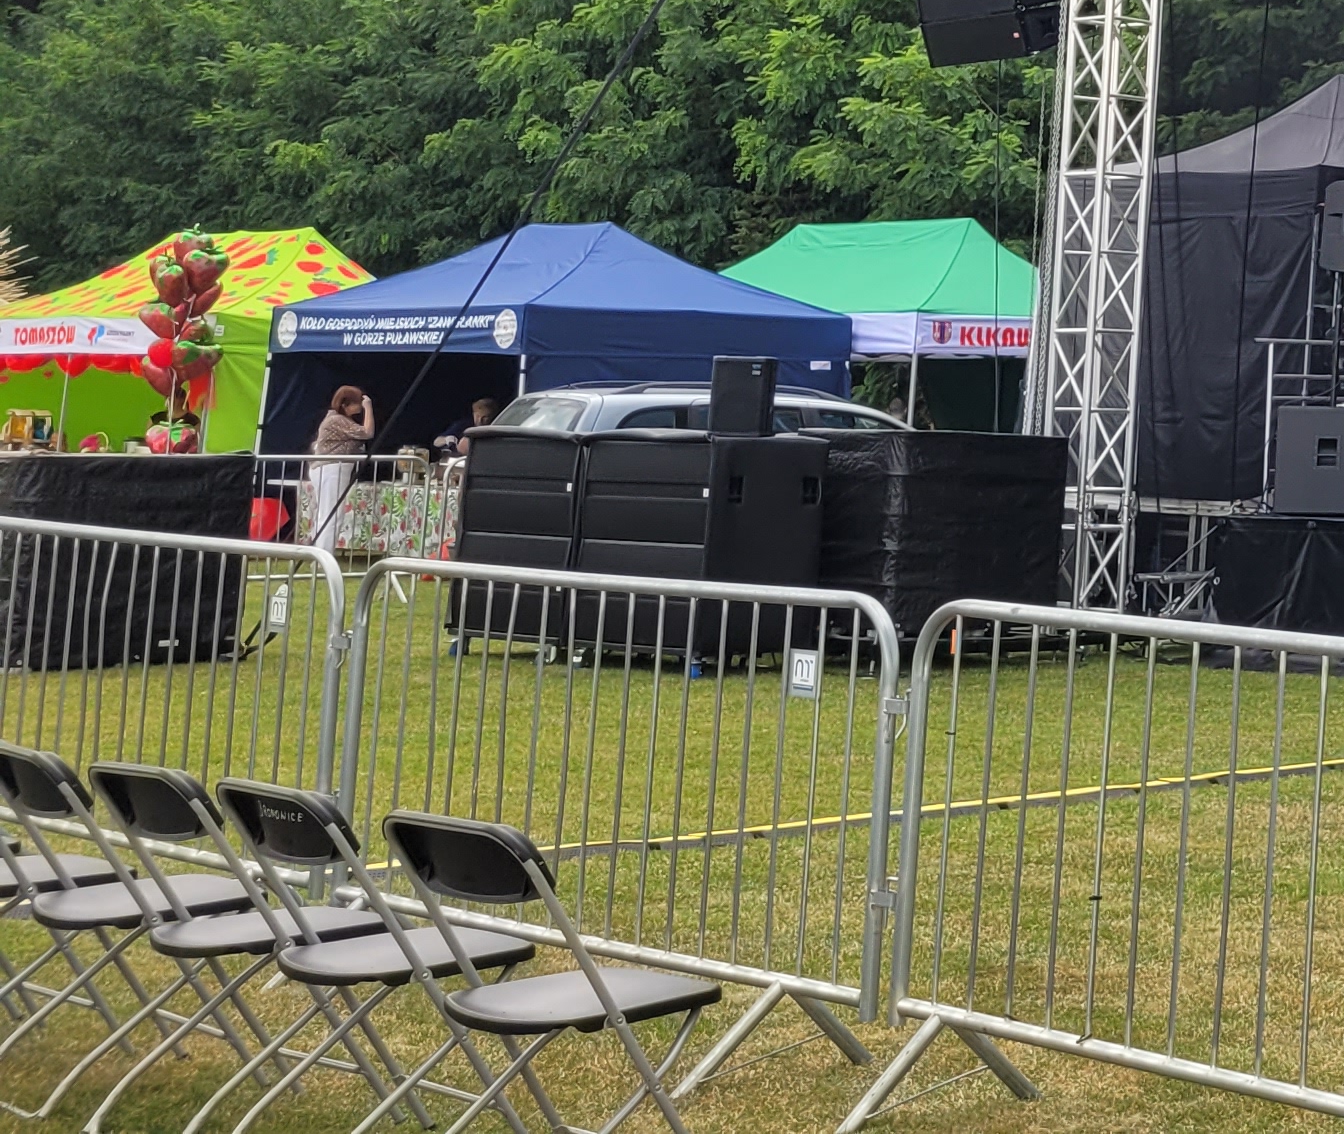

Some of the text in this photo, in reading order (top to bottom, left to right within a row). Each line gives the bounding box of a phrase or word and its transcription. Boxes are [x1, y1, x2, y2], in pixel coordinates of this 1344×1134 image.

[300, 316, 326, 330] KOŁO
[324, 314, 376, 330] GOSPODYŃ
[14, 320, 76, 346] TOMASZÓW
[343, 330, 445, 345] W GÓRZE PUŁAWSKIEJ
